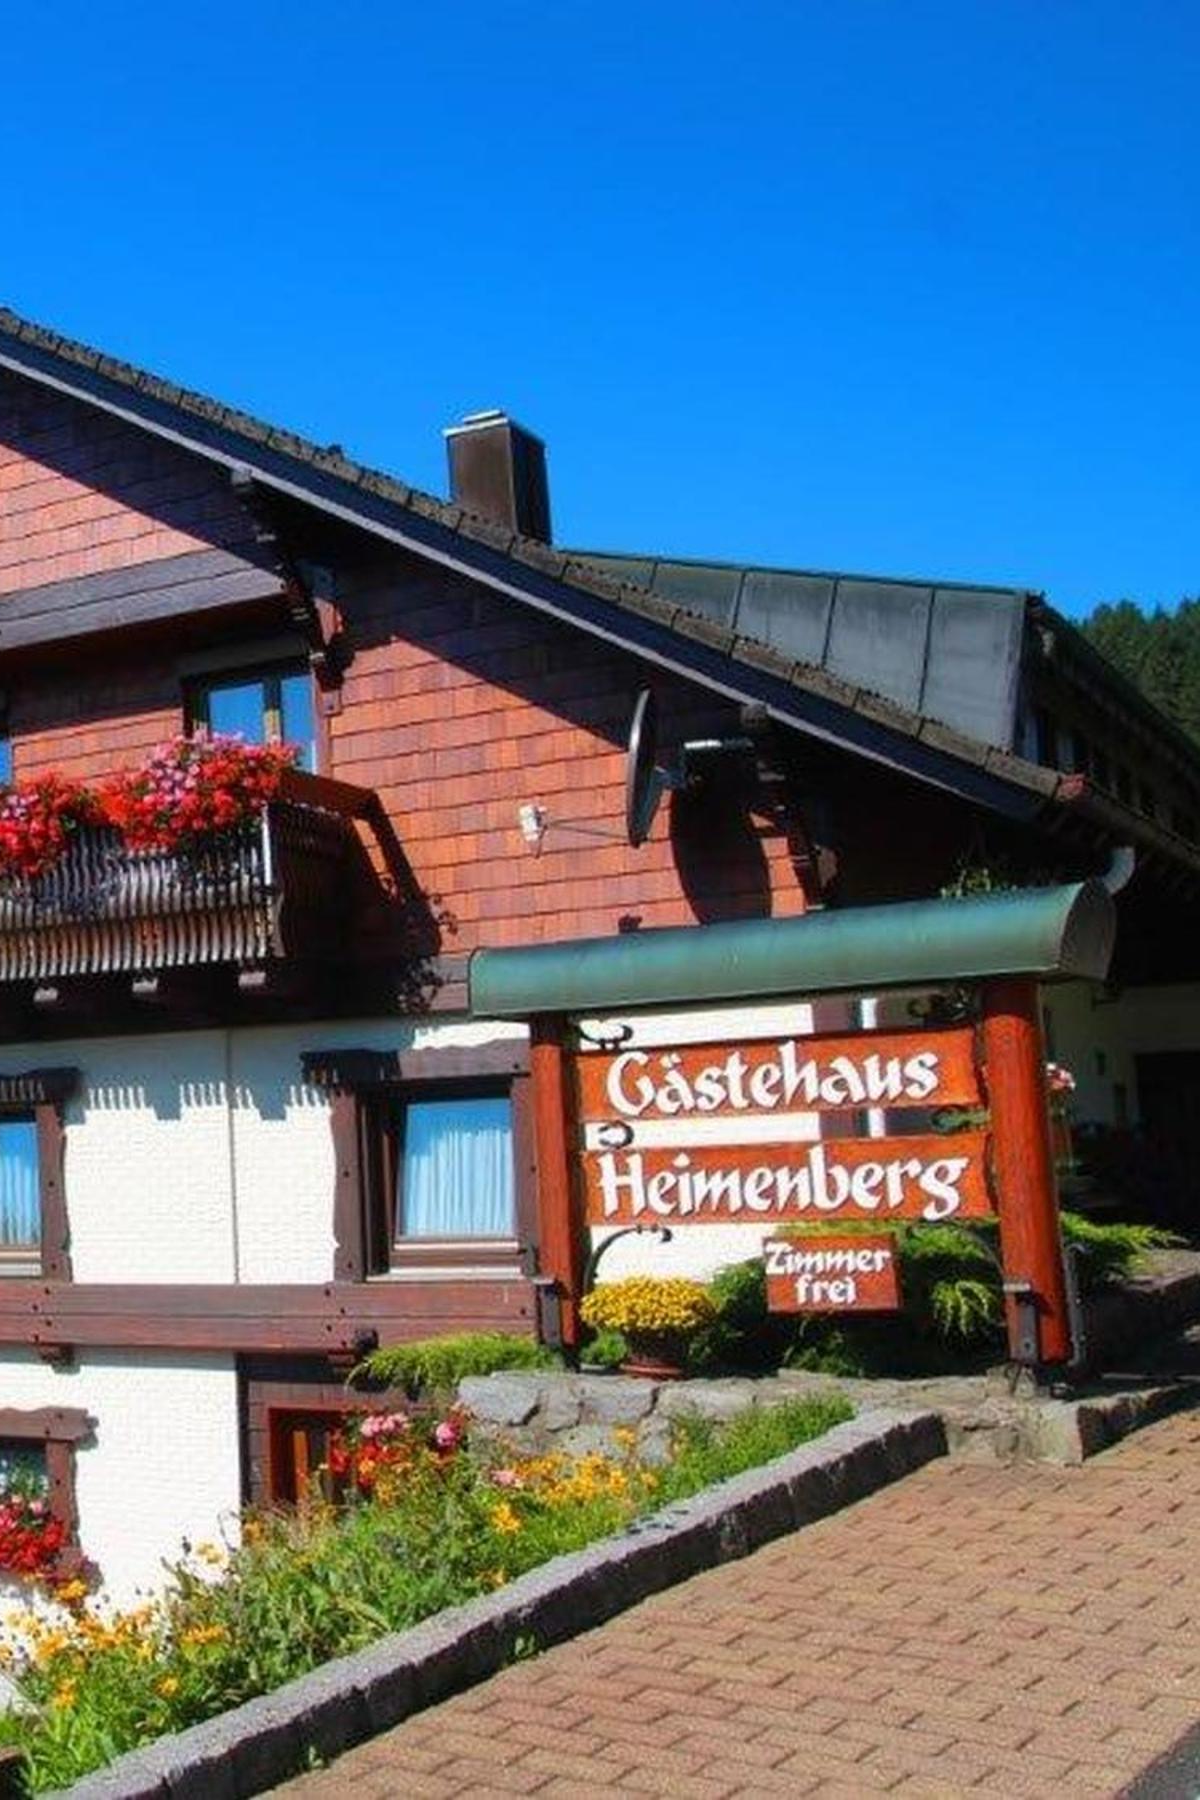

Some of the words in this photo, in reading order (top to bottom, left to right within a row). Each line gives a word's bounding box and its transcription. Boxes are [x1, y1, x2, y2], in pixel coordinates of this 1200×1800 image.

[607, 1041, 939, 1116] Gästehaus
[598, 1143, 969, 1221] Heimenberg
[767, 1242, 891, 1275] Zimmer
[794, 1276, 857, 1304] frei
